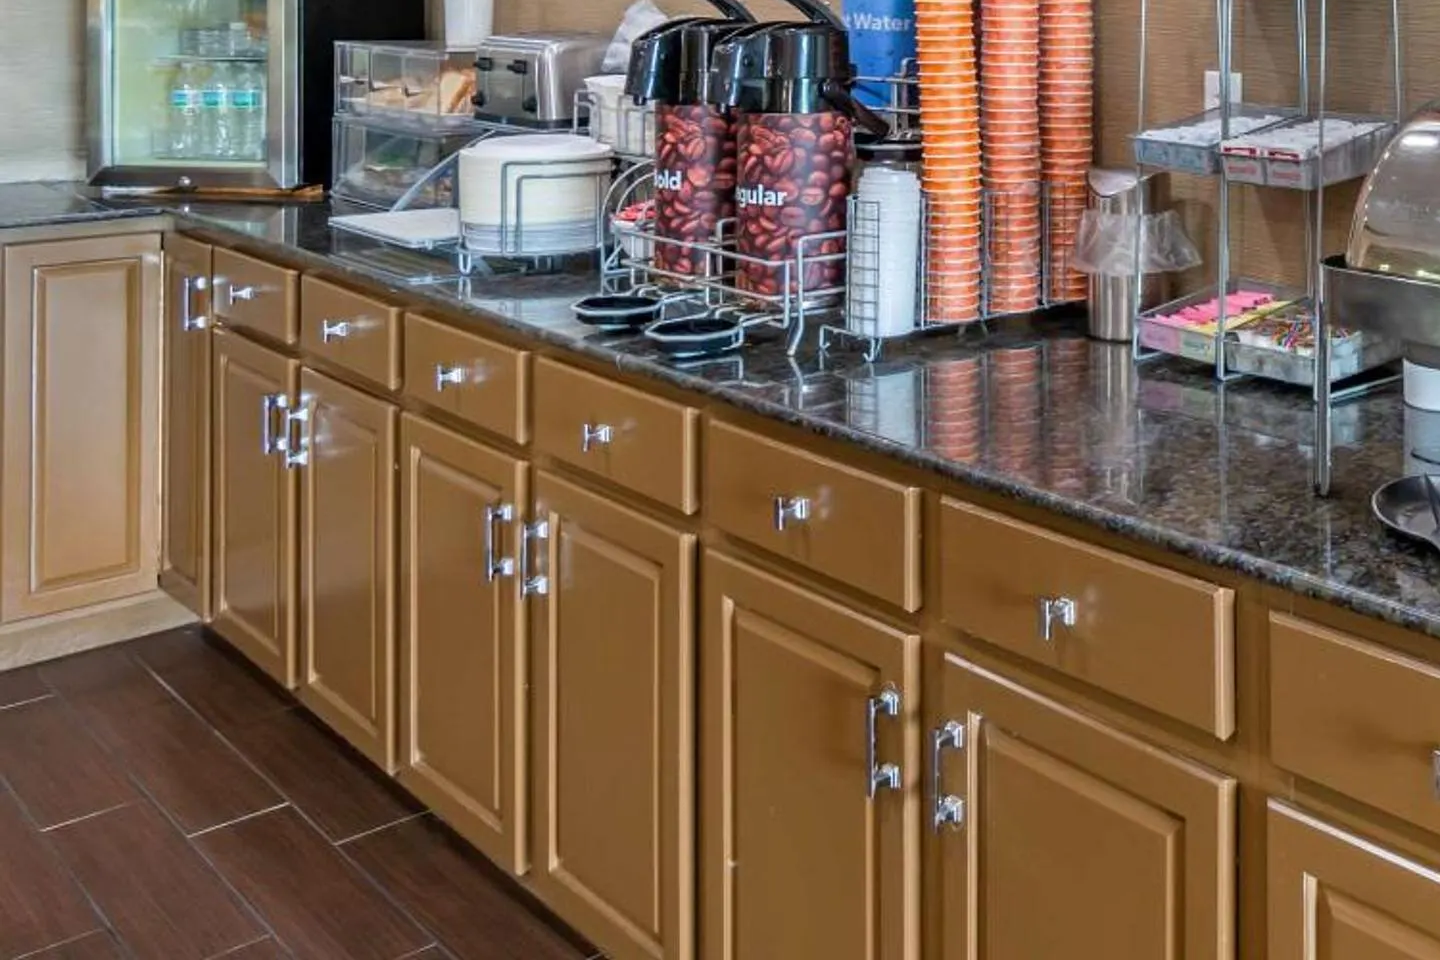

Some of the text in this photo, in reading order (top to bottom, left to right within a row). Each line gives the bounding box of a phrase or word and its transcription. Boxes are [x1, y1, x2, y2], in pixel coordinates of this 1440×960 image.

[852, 12, 911, 32] Water
[653, 169, 682, 191] old
[735, 184, 788, 208] gular
